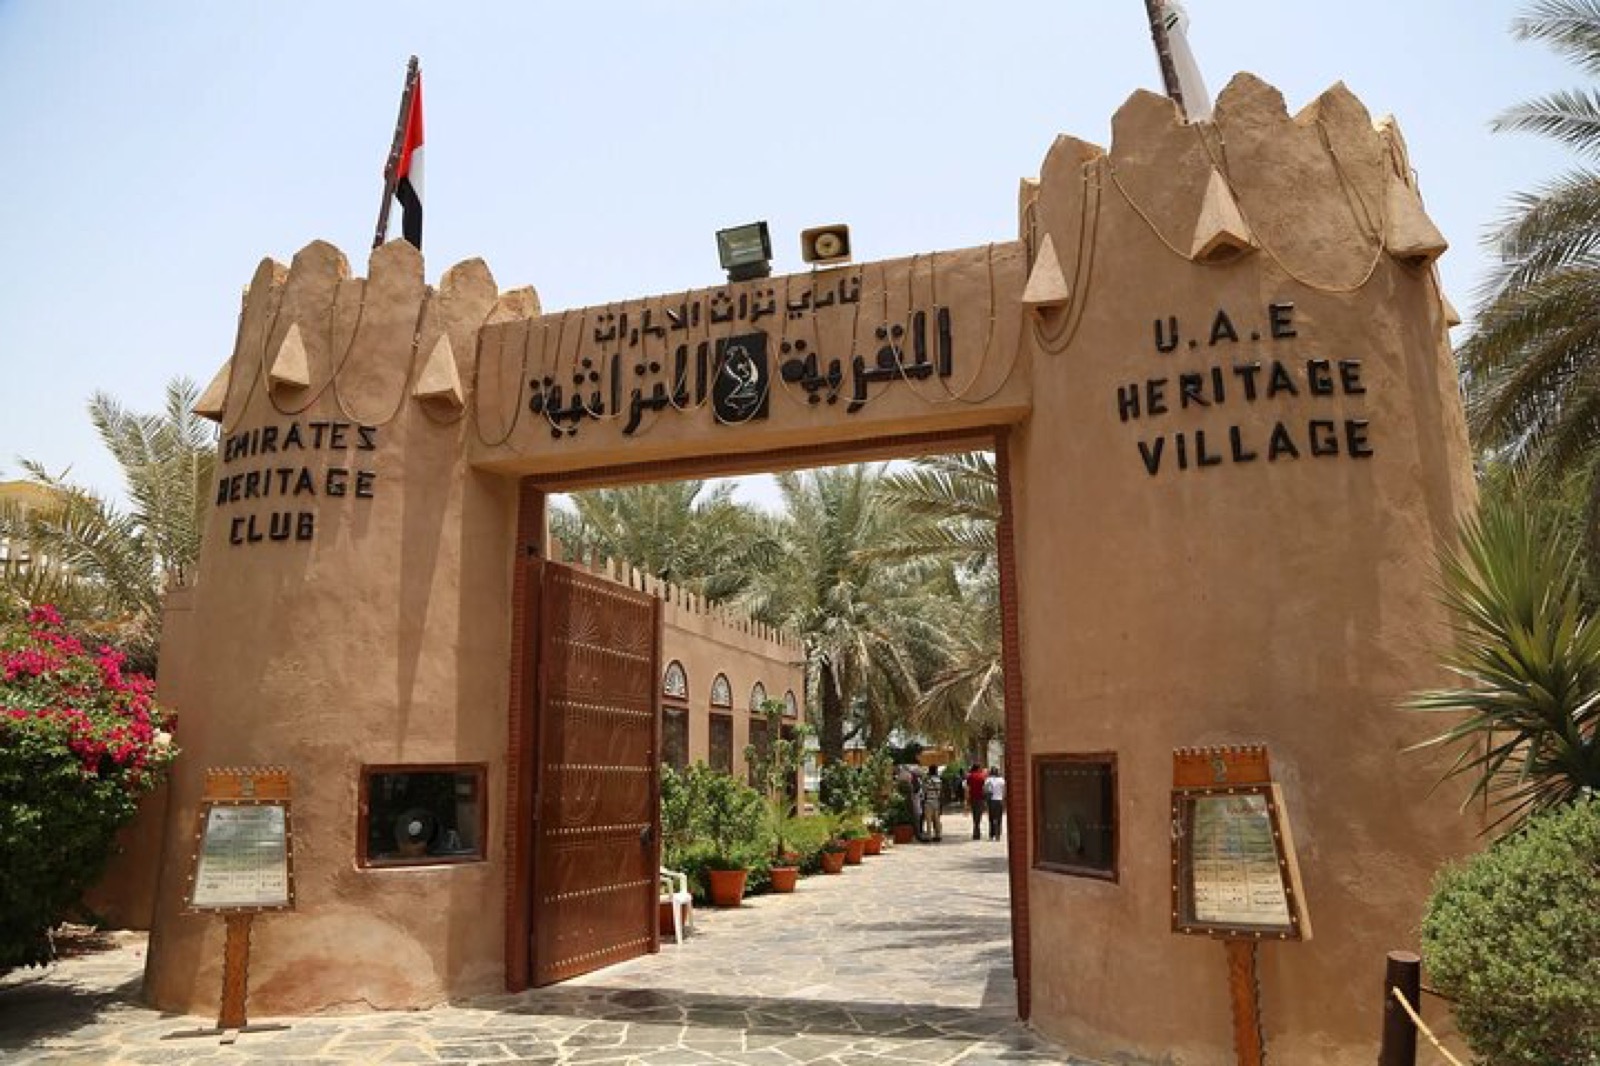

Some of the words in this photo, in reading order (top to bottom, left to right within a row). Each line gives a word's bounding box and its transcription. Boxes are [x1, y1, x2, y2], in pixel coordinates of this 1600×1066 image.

[710, 288, 776, 325] تراث
[786, 276, 860, 320] نادي
[1154, 301, 1298, 354] U.A.E
[781, 306, 953, 414] القرية
[528, 340, 711, 440] التراثية
[1116, 359, 1367, 423] HERITAGE
[223, 420, 377, 463] EMIRATES
[1137, 419, 1374, 476] VILLAGE
[215, 465, 377, 507] HERITAGE
[228, 511, 315, 546] CLUB
